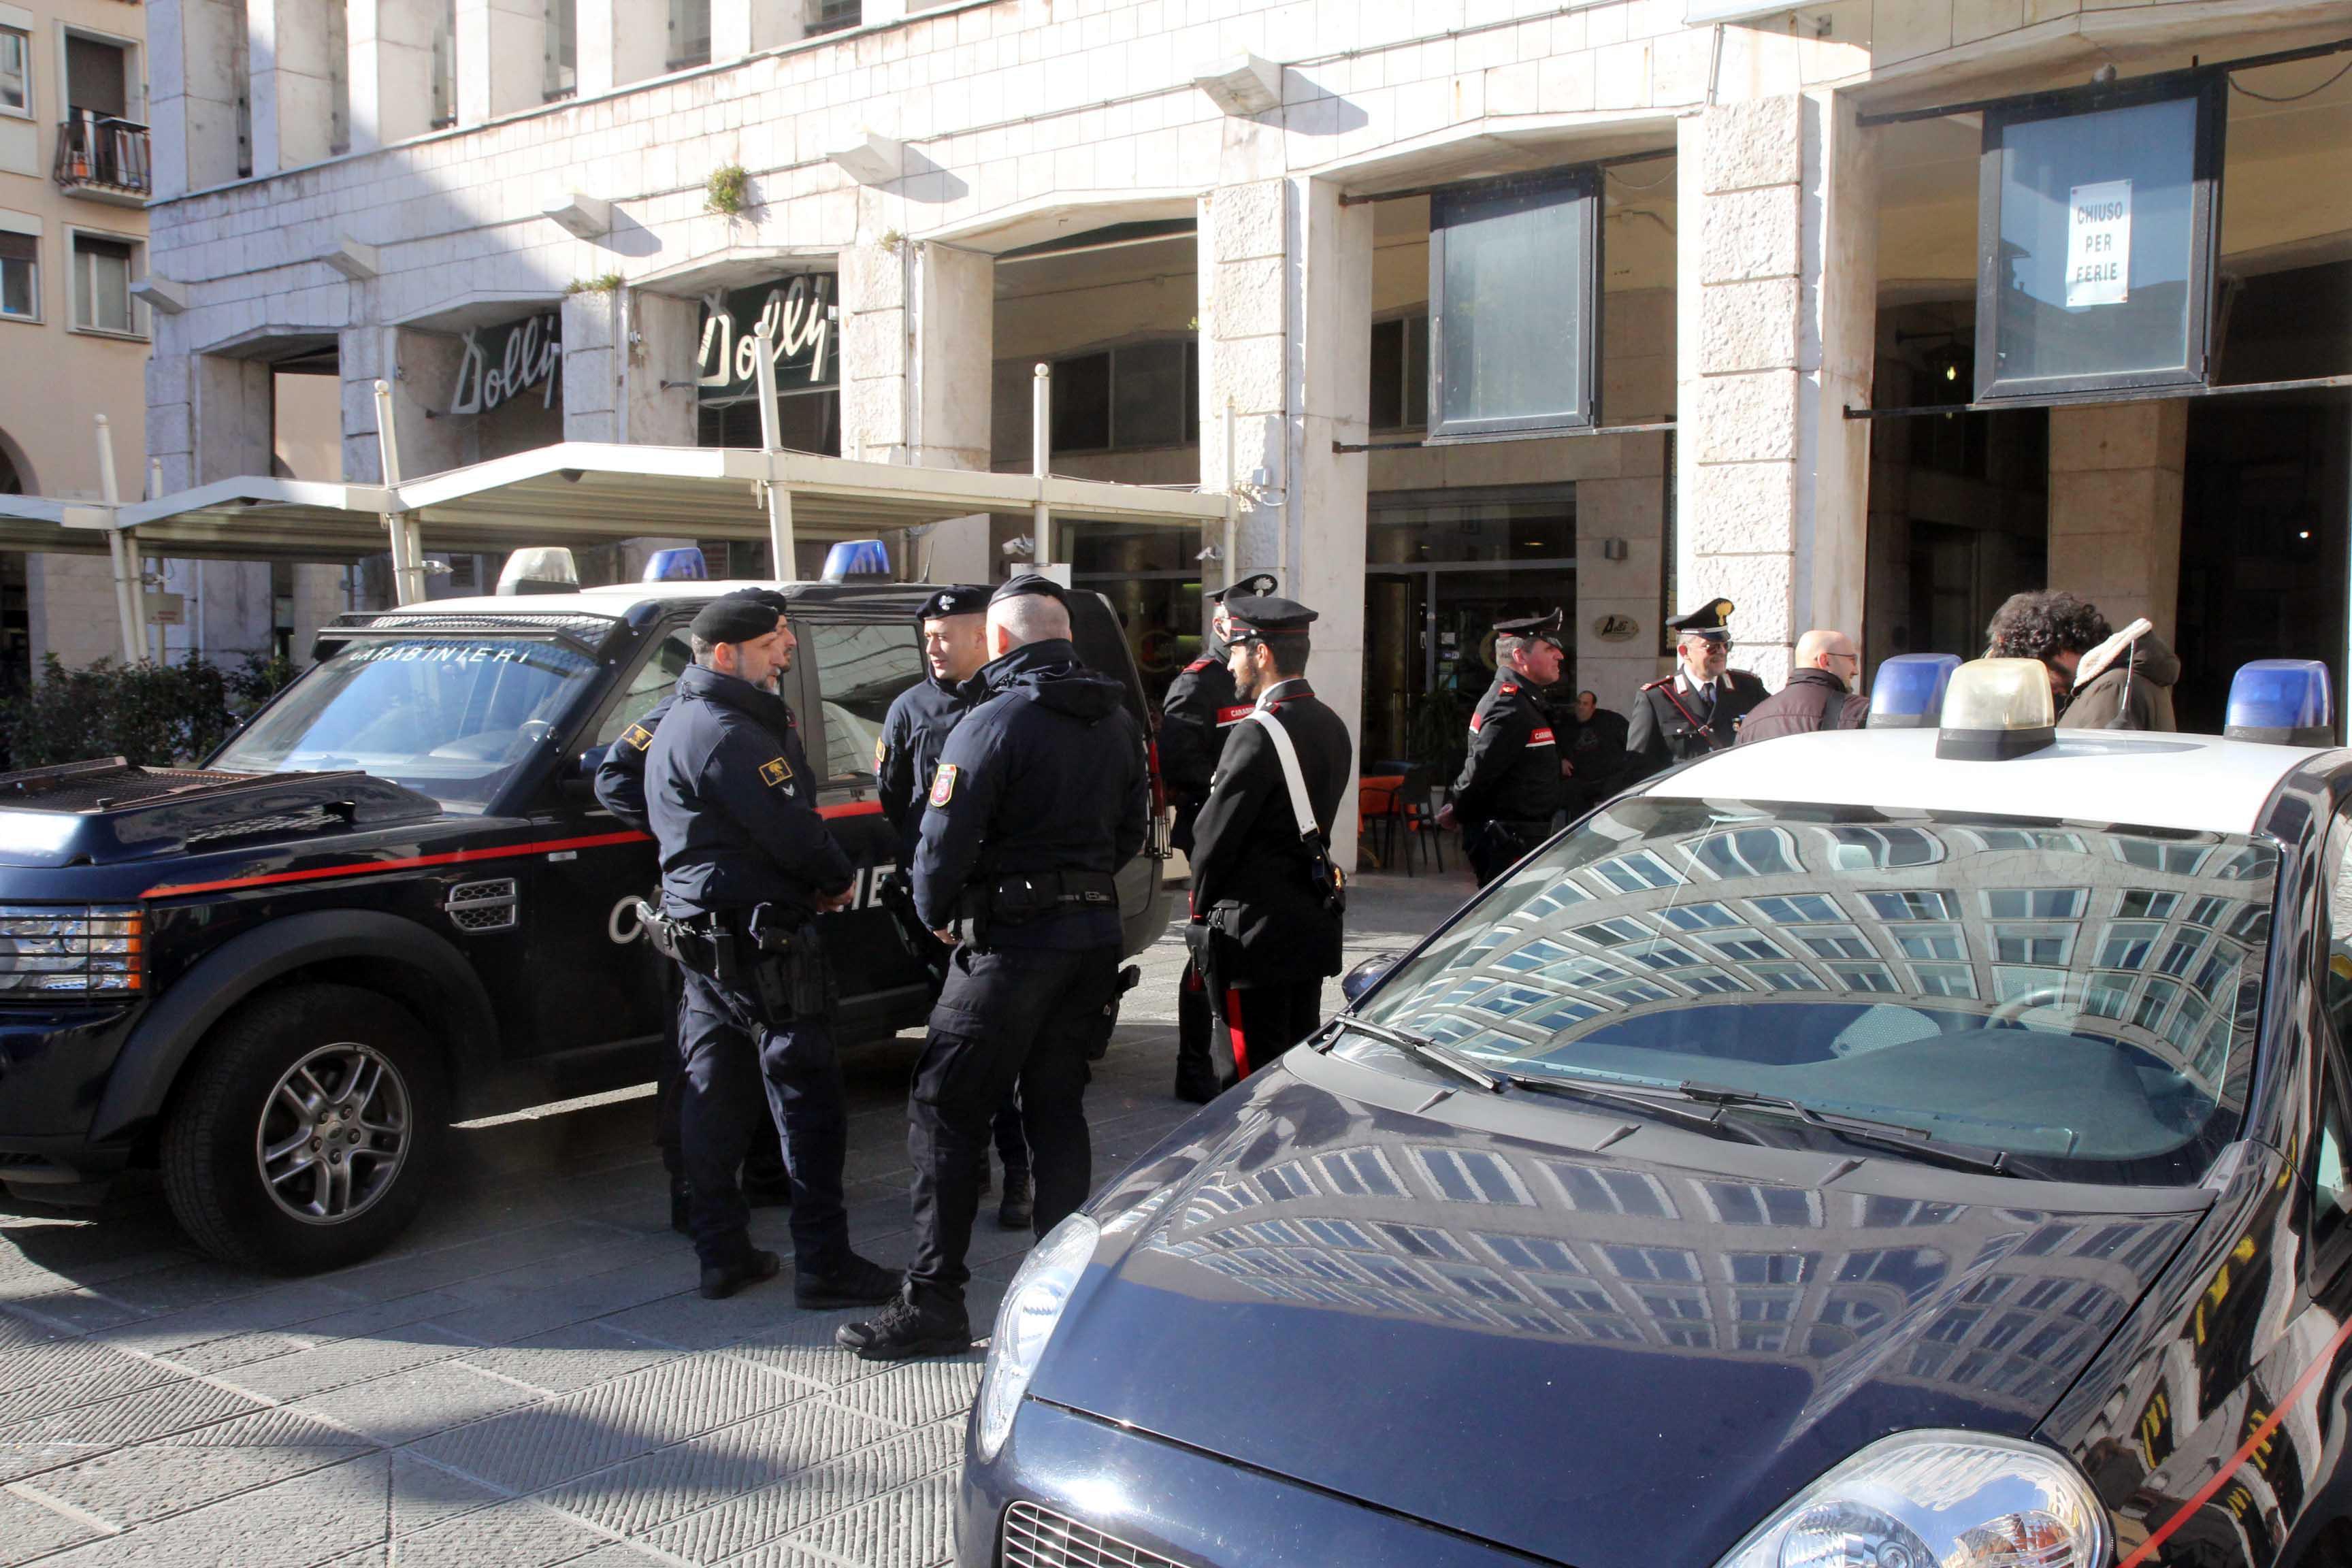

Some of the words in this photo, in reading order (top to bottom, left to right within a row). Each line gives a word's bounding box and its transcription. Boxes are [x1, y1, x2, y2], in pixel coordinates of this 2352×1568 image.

[2077, 201, 2123, 225] CHIUSO
[2085, 233, 2112, 253] PER
[2076, 263, 2118, 282] FERIE
[696, 275, 830, 387] Dolly
[451, 314, 559, 414] Dolly
